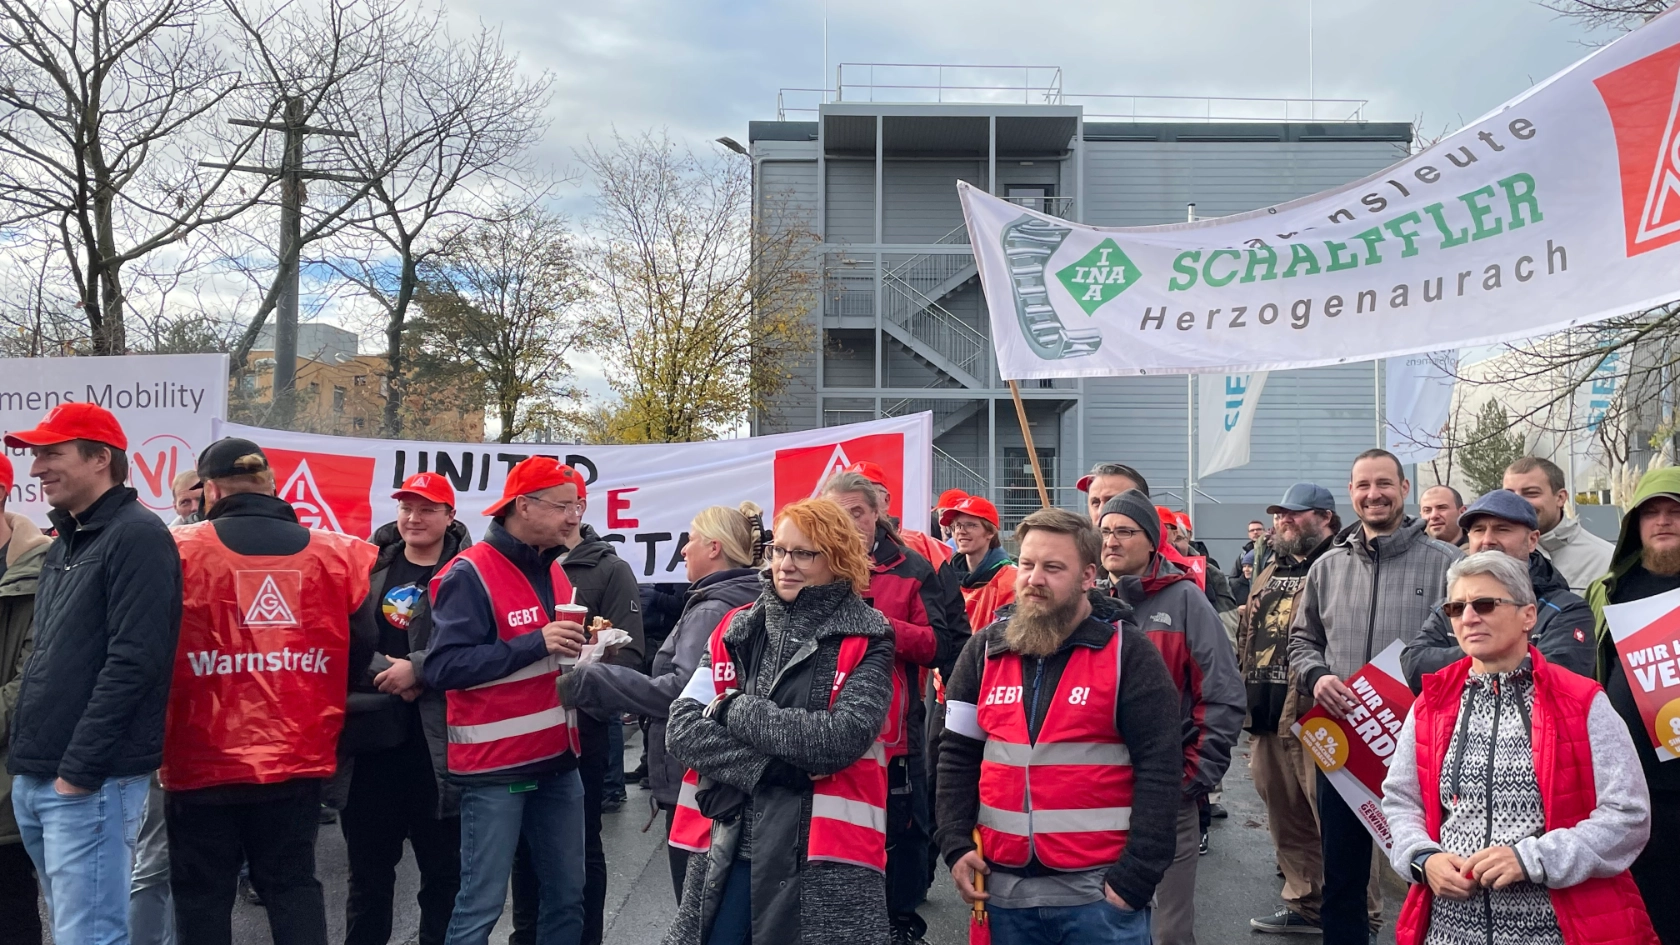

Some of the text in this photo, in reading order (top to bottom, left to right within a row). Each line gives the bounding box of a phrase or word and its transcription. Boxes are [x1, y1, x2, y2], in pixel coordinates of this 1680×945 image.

[1169, 172, 1544, 292] SCHAEFFLER
[1072, 266, 1125, 284] INA
[1140, 239, 1568, 331] Herzogenaurach
[86, 382, 204, 413] Mobility
[1224, 374, 1249, 432] SIE
[393, 450, 598, 492] UNITD
[508, 606, 539, 628] GEBT
[1626, 644, 1670, 667] WIR
[713, 662, 736, 682] EB
[1633, 659, 1680, 693] VE
[1068, 686, 1090, 705] 8!
[1352, 675, 1384, 711] WIR
[1367, 800, 1390, 830] SOLIDAR
